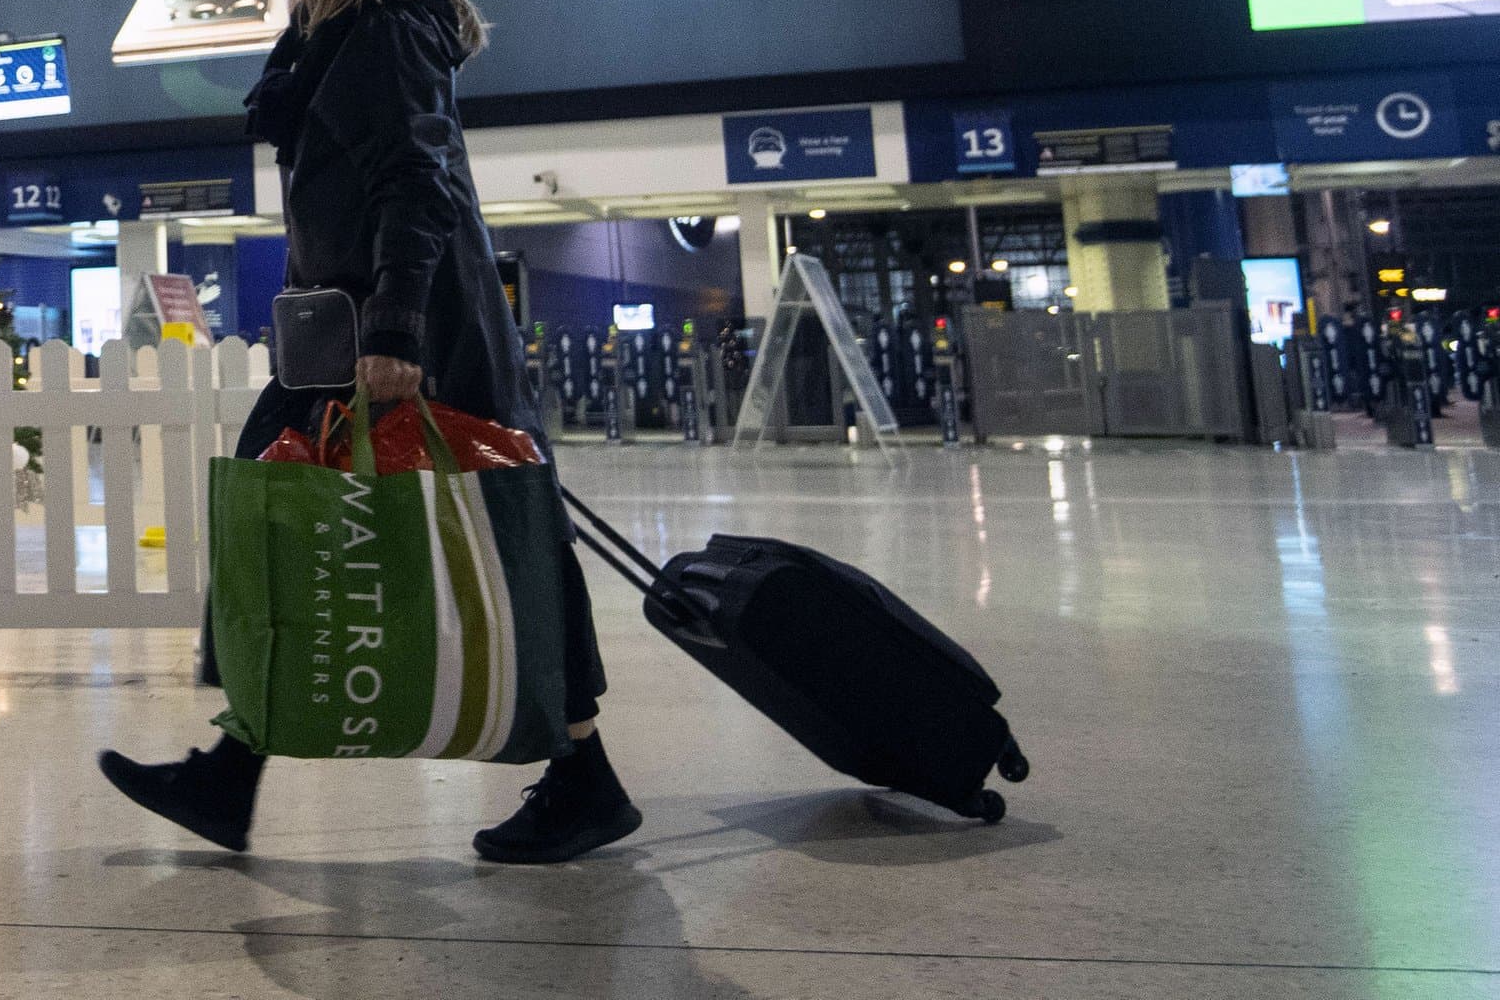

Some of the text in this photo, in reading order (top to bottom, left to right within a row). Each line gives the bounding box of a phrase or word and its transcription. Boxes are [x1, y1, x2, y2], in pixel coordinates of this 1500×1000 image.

[962, 128, 1005, 158] 13
[12, 185, 41, 209] 12
[311, 521, 332, 703] & PARTNERS
